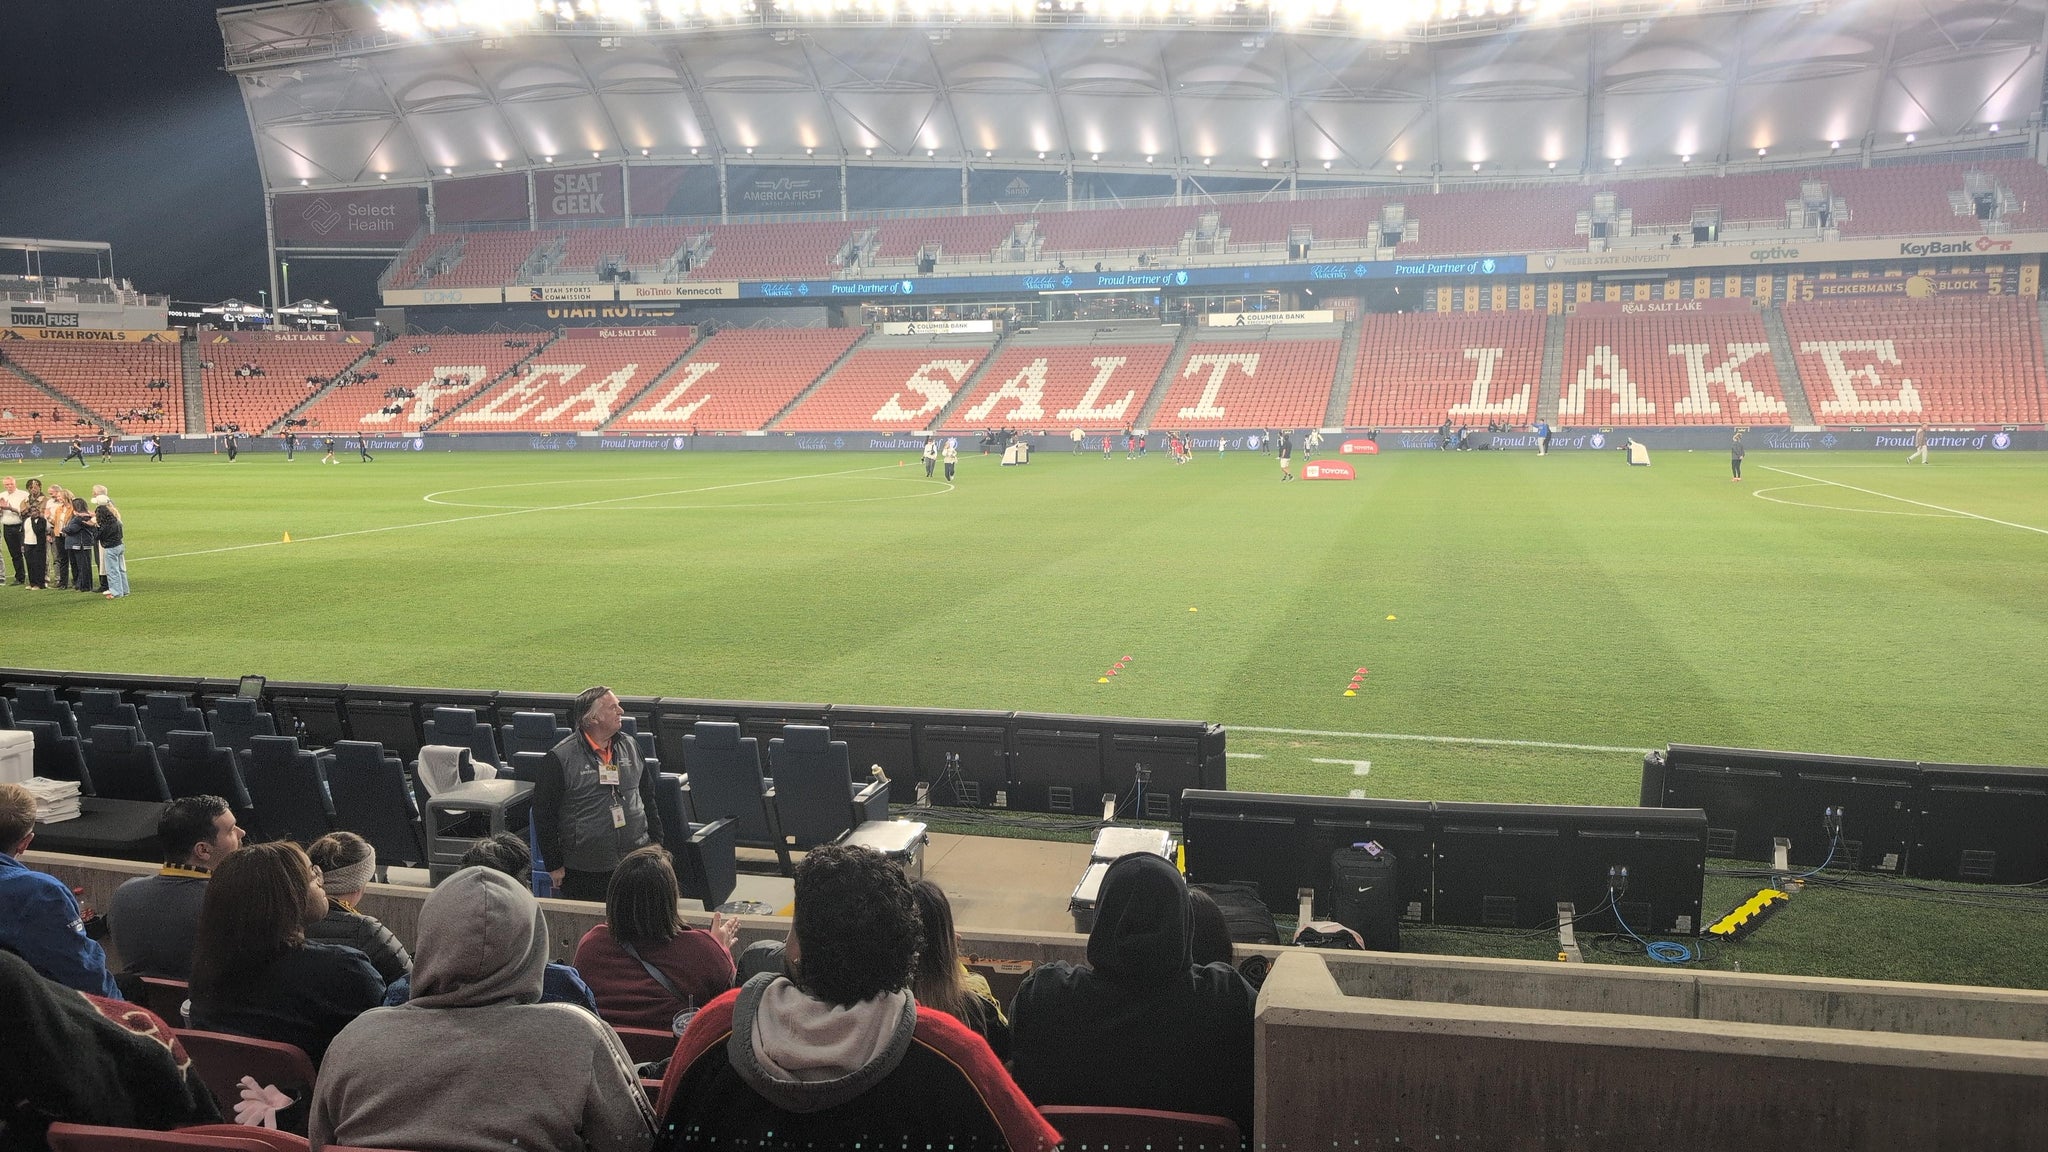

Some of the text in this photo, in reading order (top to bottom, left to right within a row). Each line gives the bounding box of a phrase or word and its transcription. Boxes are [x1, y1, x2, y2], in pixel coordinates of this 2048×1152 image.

[553, 172, 601, 193] SEAT
[744, 189, 823, 201] AMERICA FIRST
[348, 203, 396, 216] Select
[552, 193, 605, 214] GEEK
[349, 218, 394, 231] Health
[1750, 246, 1799, 262] aptive
[1900, 241, 1973, 256] KeyBank
[1564, 254, 1670, 265] WEBER STATE UNIVERSITY
[1395, 262, 1478, 274] Proud Partner of
[1098, 273, 1172, 285] Proud Partner of
[676, 286, 722, 295] Kennecott
[831, 282, 899, 294] Proud Partner of
[1802, 285, 1814, 300] 5
[1822, 280, 1978, 294] BECKERMAN'S BLOCK
[1988, 279, 2001, 295] 5
[1648, 303, 1675, 312] SALT
[1679, 299, 1702, 311] LAKE
[12, 314, 78, 326] DURA FUSE
[40, 330, 126, 340] UTAH ROYALS
[872, 353, 1260, 422] SALT
[1447, 341, 1924, 417] LAKE
[130, 442, 139, 454] of
[370, 440, 400, 448] Partner
[402, 440, 411, 451] of
[600, 438, 670, 450] Proud Partner of
[870, 439, 897, 448] Proud
[1192, 437, 1243, 450] Partnr of
[1492, 436, 1524, 446] Proud
[1574, 435, 1586, 448] of
[1875, 434, 1987, 450] Proud artner of
